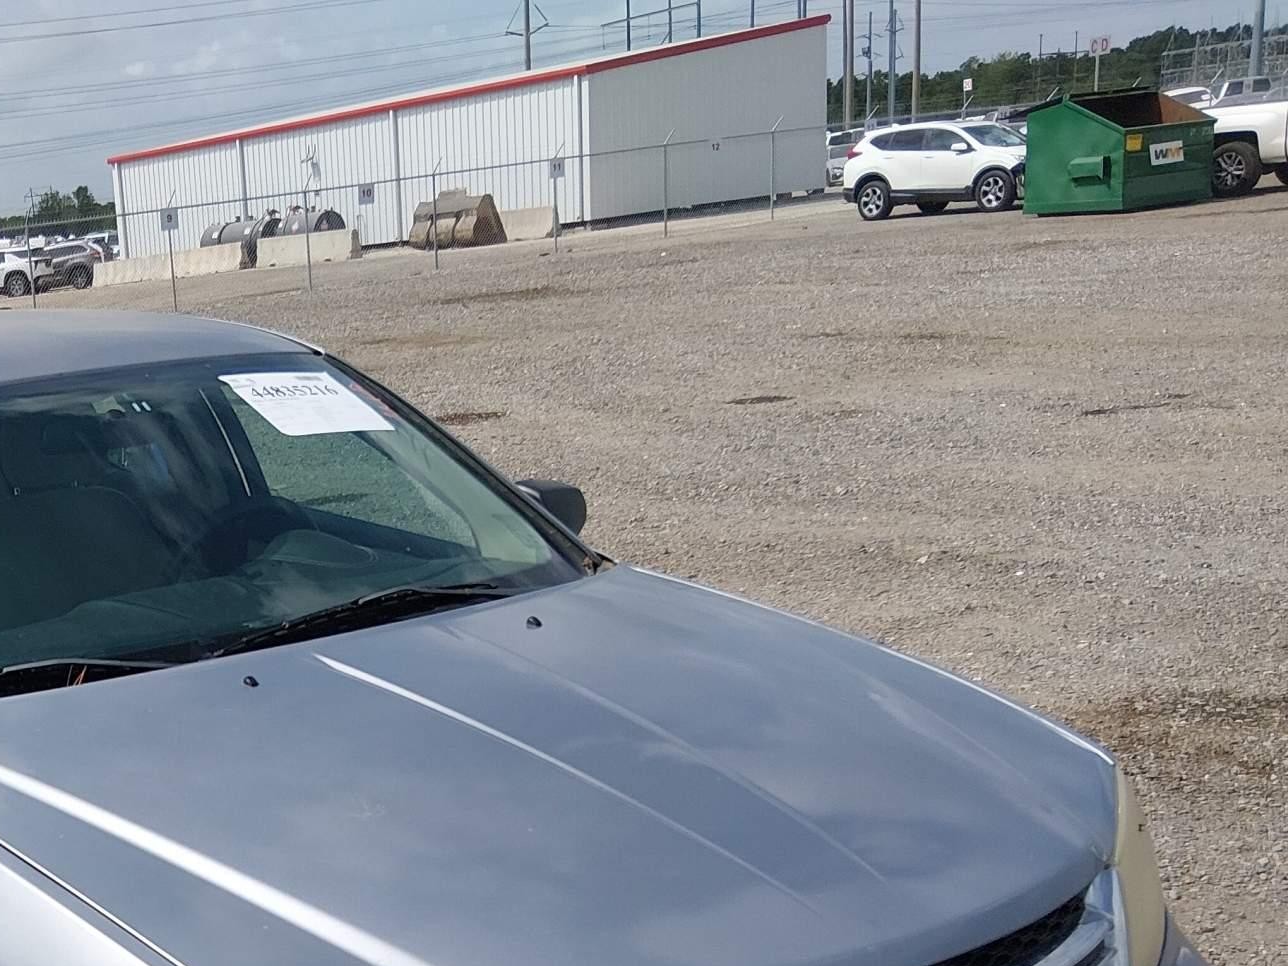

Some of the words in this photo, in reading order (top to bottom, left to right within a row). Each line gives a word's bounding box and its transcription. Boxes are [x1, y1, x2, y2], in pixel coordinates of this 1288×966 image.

[553, 163, 561, 172] 11
[362, 188, 372, 198] 10
[166, 214, 172, 223] 9
[251, 385, 338, 398] 44835216
